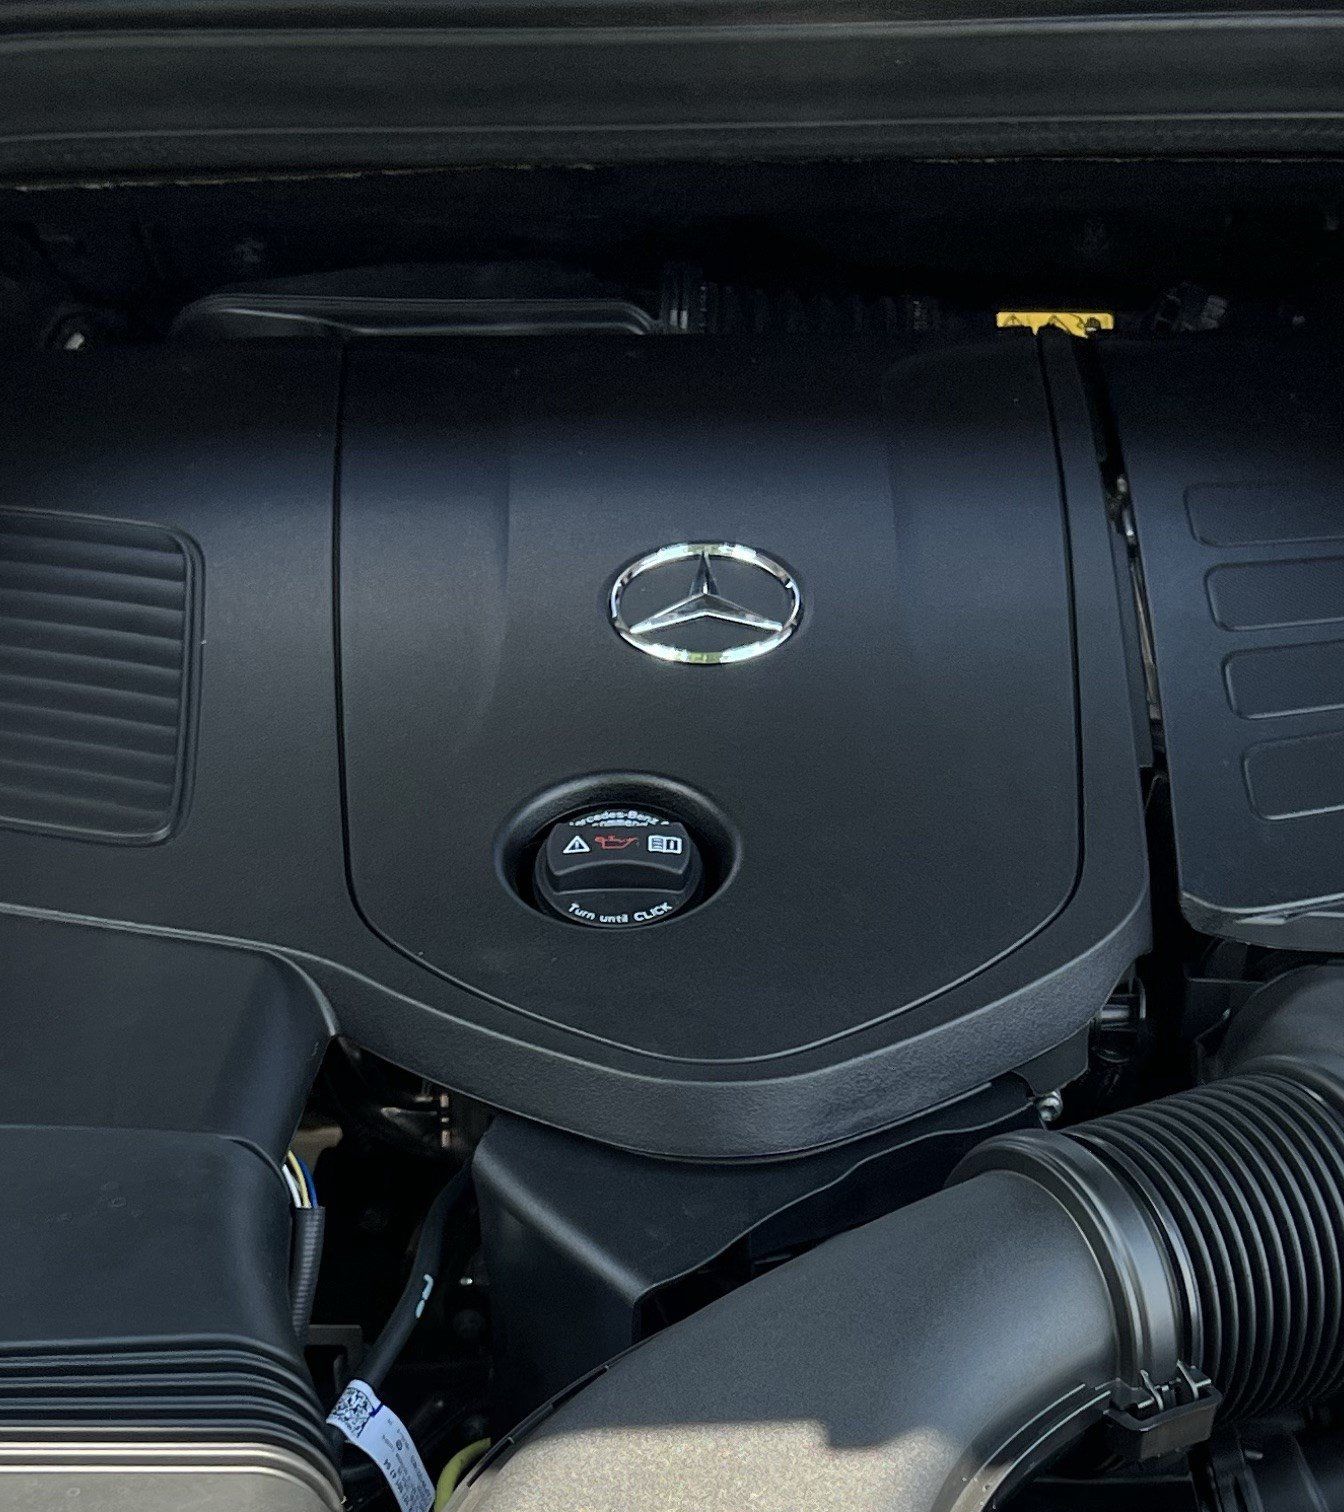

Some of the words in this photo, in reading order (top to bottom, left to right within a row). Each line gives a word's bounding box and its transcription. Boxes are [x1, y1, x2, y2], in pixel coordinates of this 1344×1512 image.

[568, 902, 596, 921] Turn
[599, 912, 628, 924] until
[633, 901, 673, 922] CLICK
